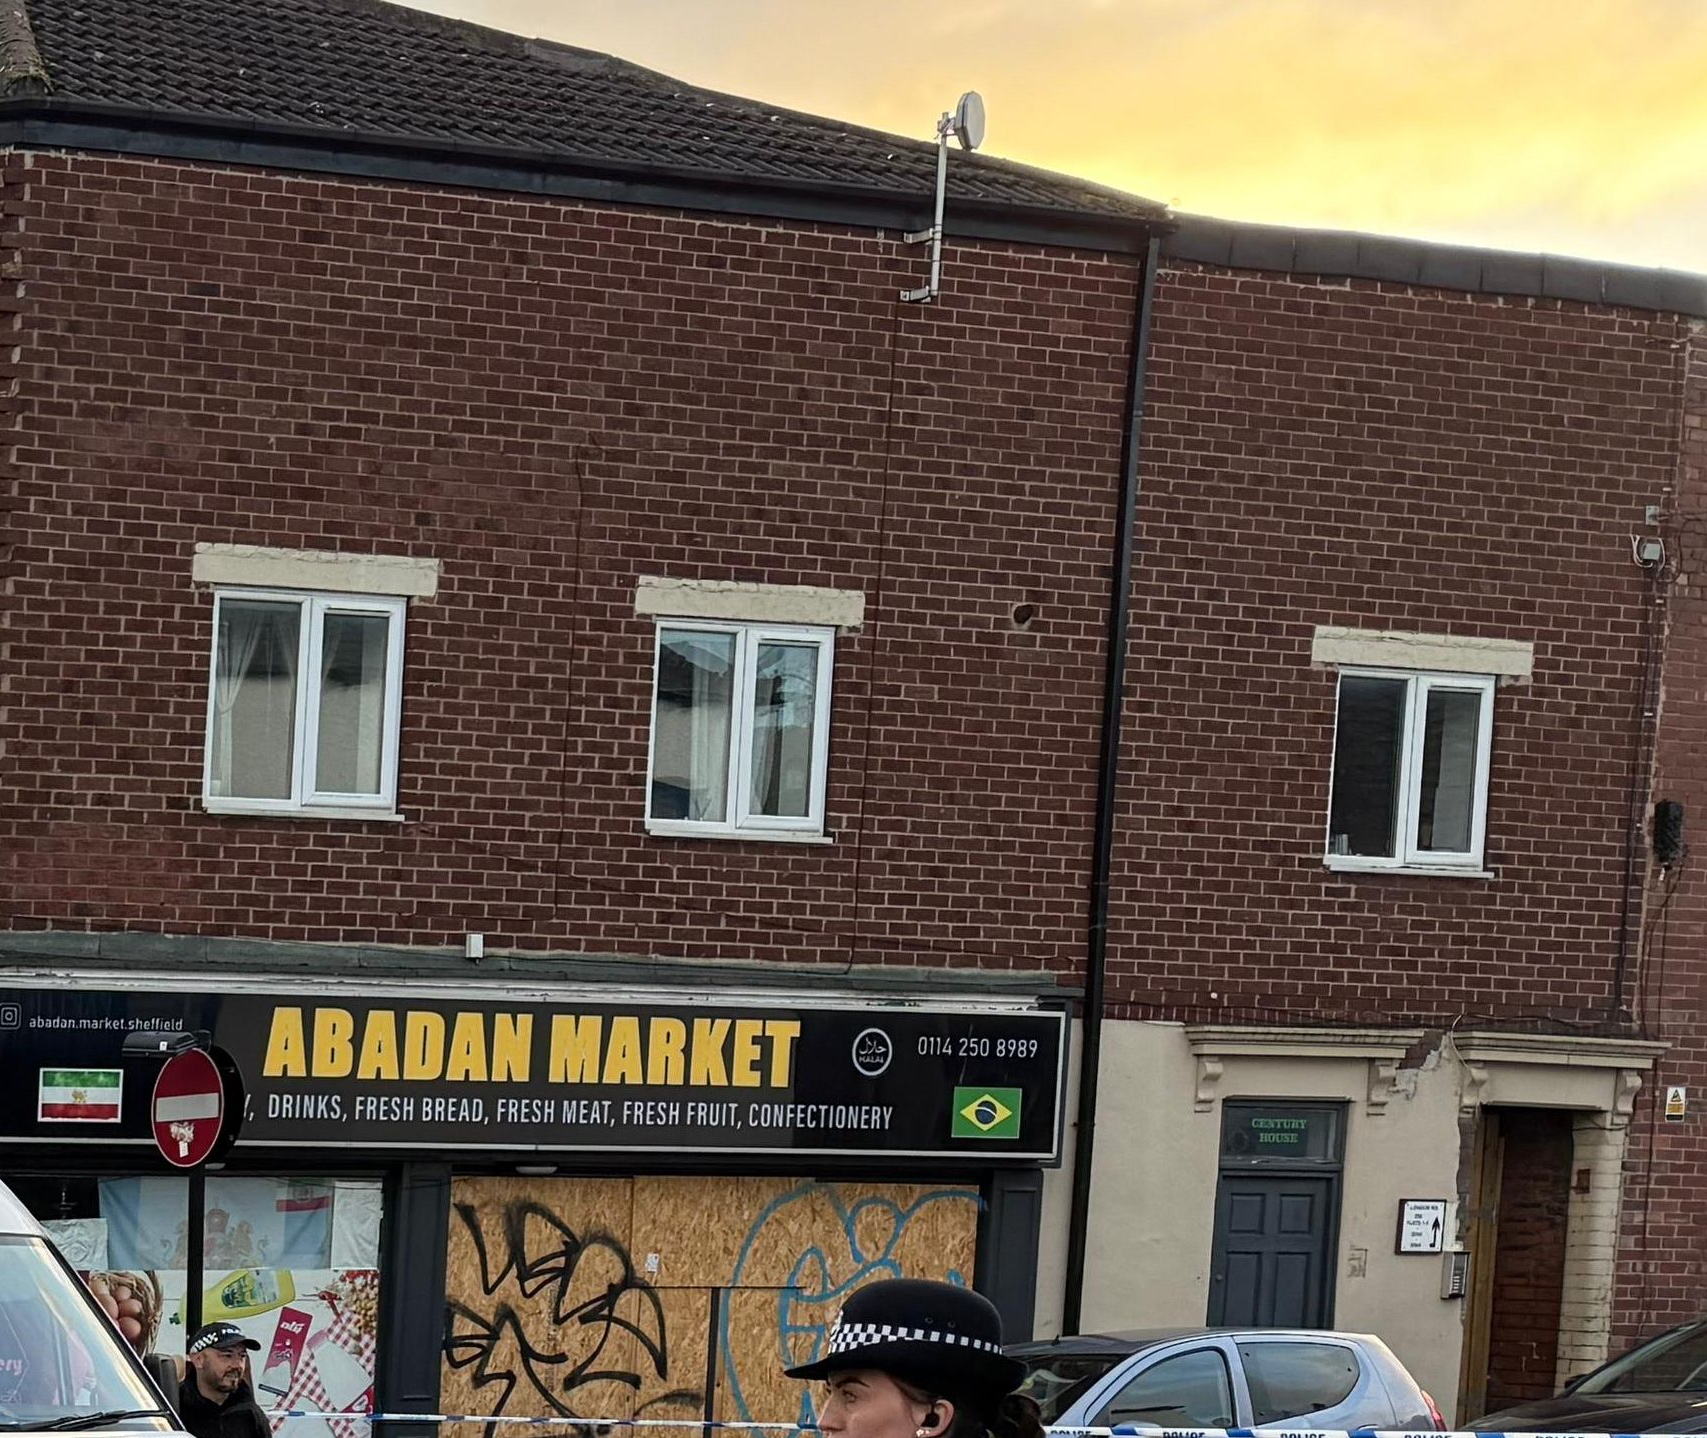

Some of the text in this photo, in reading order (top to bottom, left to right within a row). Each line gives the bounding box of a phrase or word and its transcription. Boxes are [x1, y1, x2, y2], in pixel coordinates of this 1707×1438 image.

[29, 1015, 184, 1032] abadan.market.sheffield
[262, 1006, 802, 1089] ABADAN MARKET
[917, 1036, 1038, 1058] 0114 250 8989
[267, 1093, 348, 1123] DRINKS,
[354, 1096, 415, 1121] FRESH
[421, 1097, 490, 1125] BREAD,
[496, 1098, 555, 1124] FRESH
[561, 1100, 616, 1129] MEAT,
[622, 1101, 681, 1126] FRESH
[686, 1102, 742, 1130] FRUIT,
[748, 1103, 894, 1131] CONFECTIONERY
[1251, 1118, 1308, 1129] CENTURY
[1258, 1132, 1299, 1143] HOUSE
